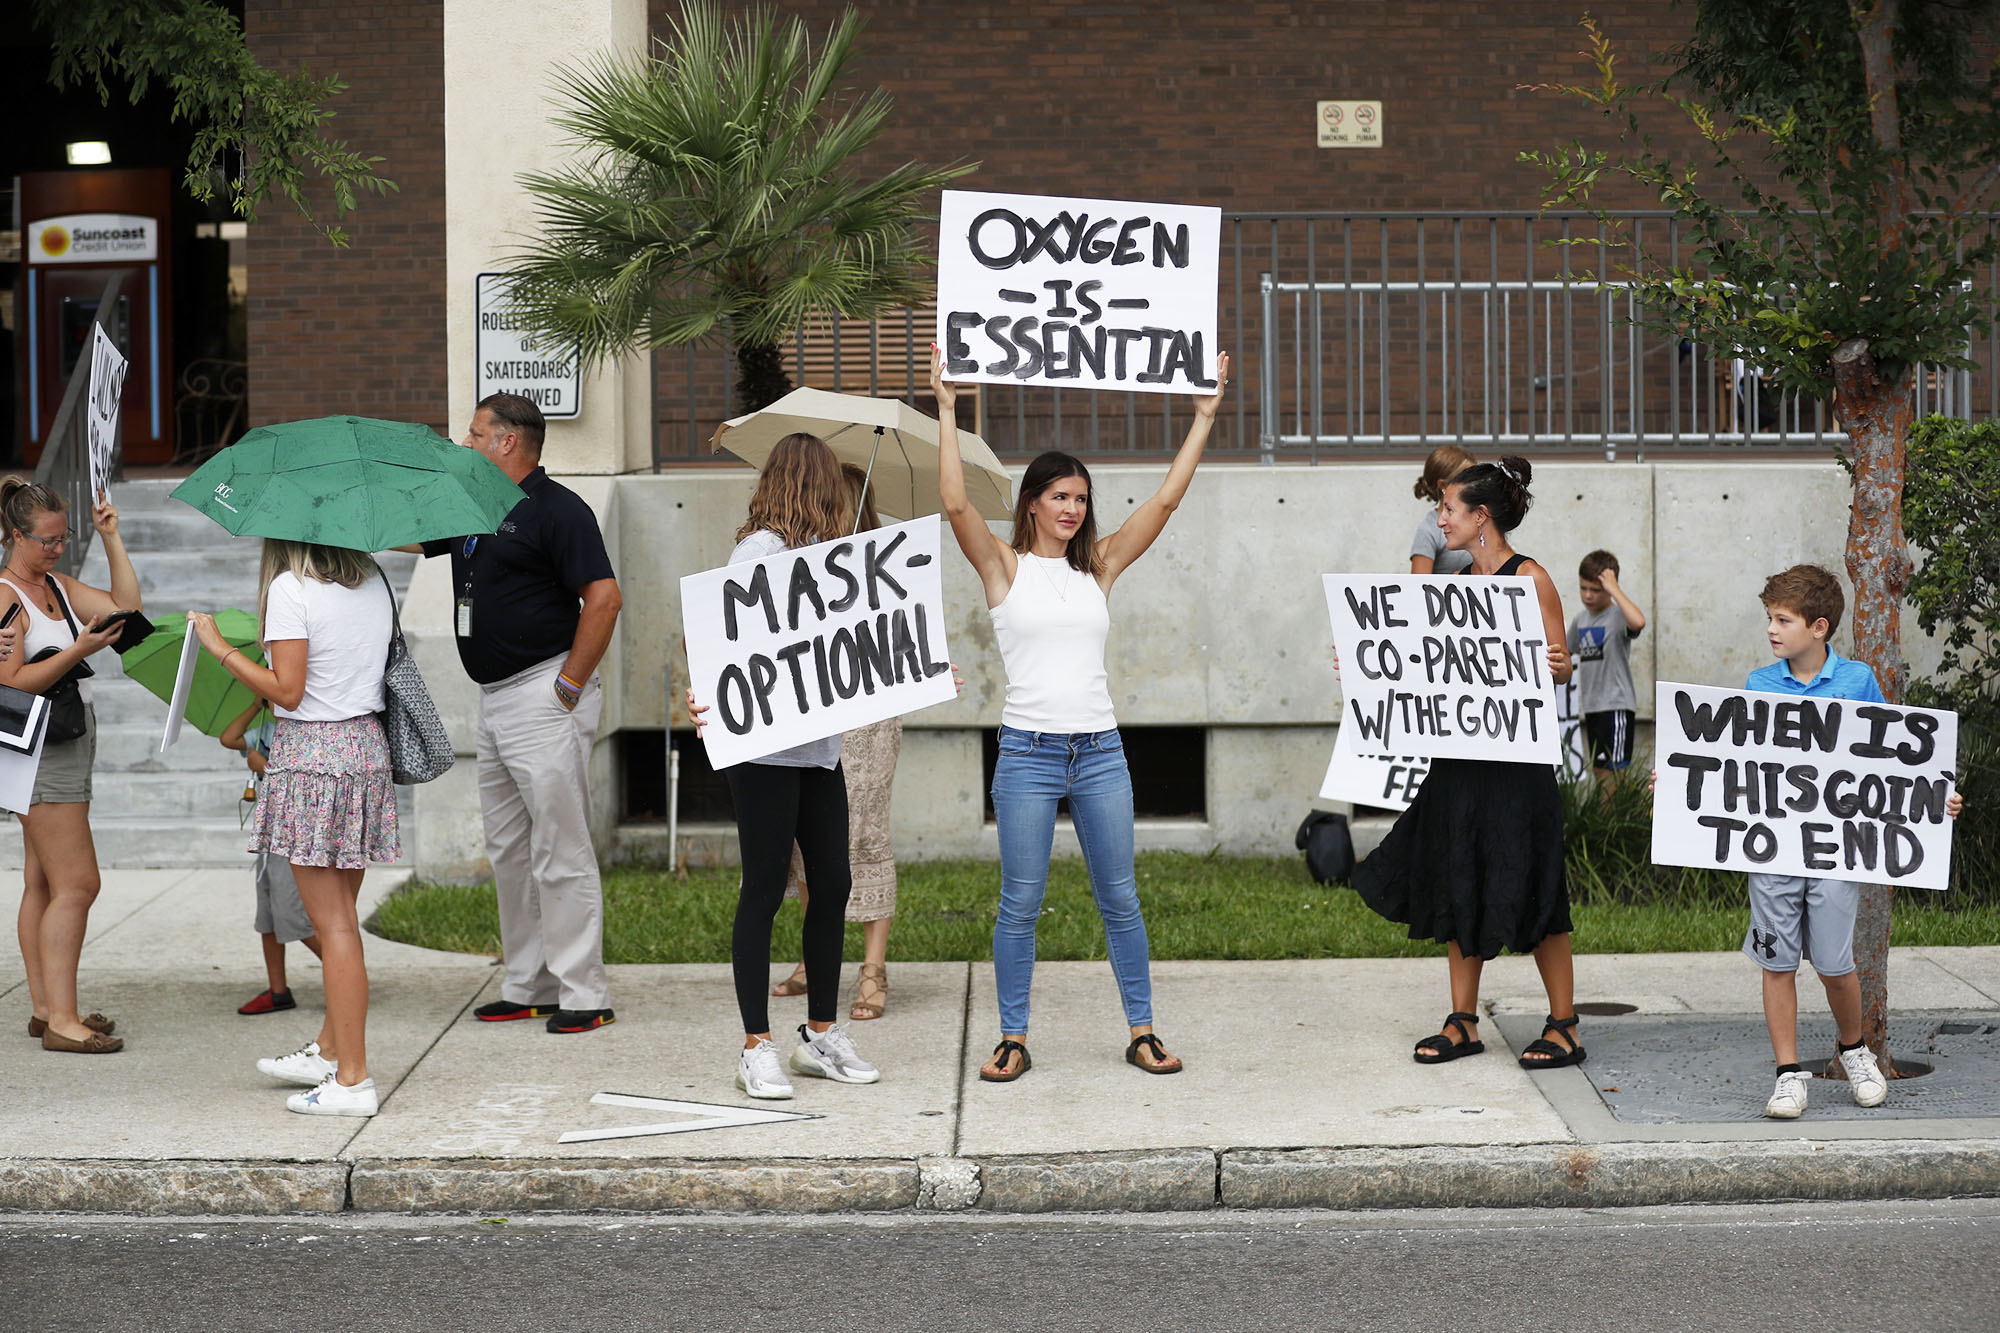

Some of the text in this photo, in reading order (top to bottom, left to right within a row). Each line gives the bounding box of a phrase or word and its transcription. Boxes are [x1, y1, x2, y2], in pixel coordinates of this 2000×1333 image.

[72, 226, 145, 241] Suncoast
[72, 241, 146, 253] Credit Union
[968, 208, 1190, 270] OXYGEN
[486, 361, 571, 379] SKATEBOARDS
[947, 311, 1218, 388] ESSENTIAL
[498, 388, 561, 406] OWED
[1344, 583, 1525, 632] WE DON'T
[717, 602, 949, 735] OPTIONAL
[1457, 695, 1544, 742] GOVT
[1674, 690, 1939, 765] WHEN IS
[1697, 815, 1924, 878] TO END
